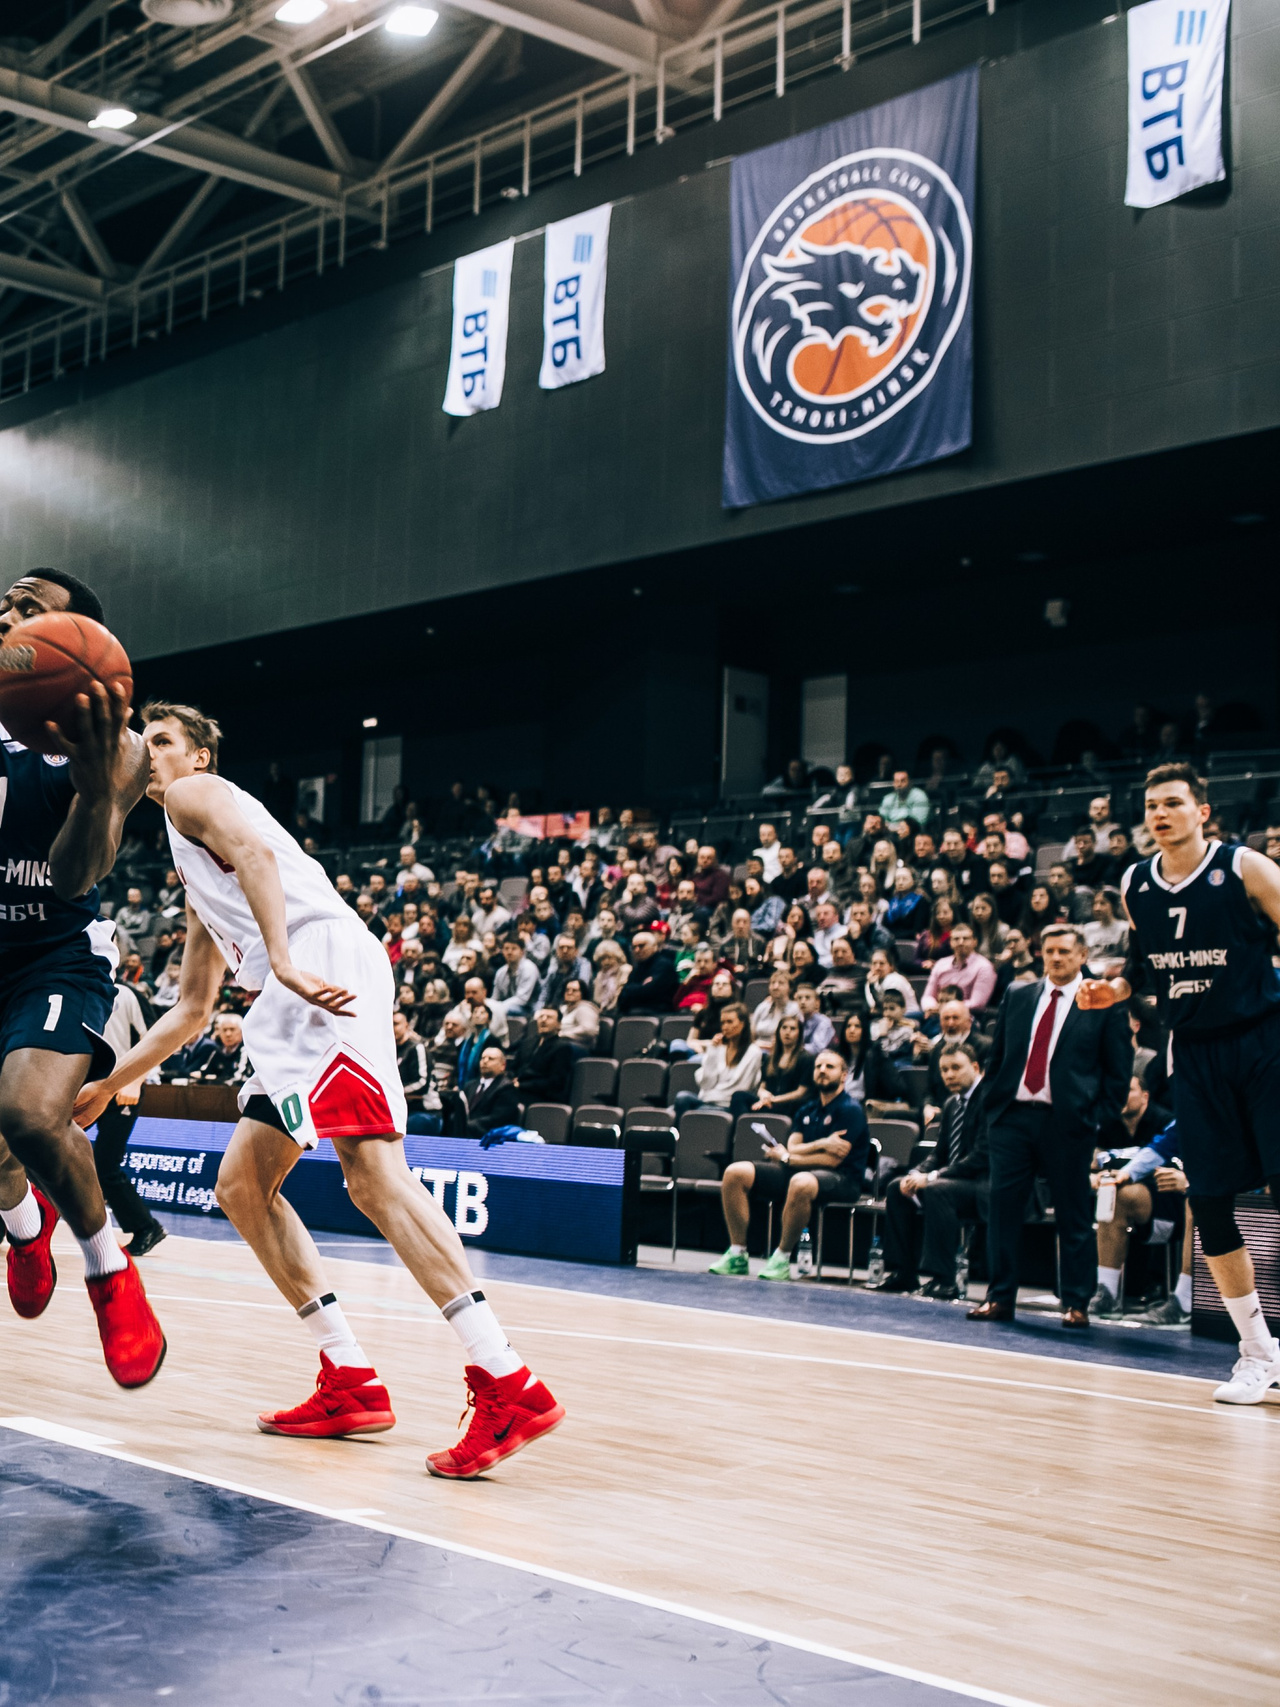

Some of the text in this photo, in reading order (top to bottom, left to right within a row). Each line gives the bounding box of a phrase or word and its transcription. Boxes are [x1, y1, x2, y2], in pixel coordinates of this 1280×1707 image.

[1141, 59, 1189, 181] ВТБ
[773, 164, 931, 243] BASKETBALL CLUB
[461, 309, 488, 398] ВТБ
[552, 274, 583, 369] ВТБ
[769, 347, 930, 429] TSMOKI-MINSK
[1168, 906, 1188, 940] 7
[43, 994, 64, 1031] 1
[129, 1152, 187, 1173] sponsor
[188, 1152, 207, 1174] of
[177, 1182, 220, 1212] Leag
[411, 1167, 489, 1237] TB
